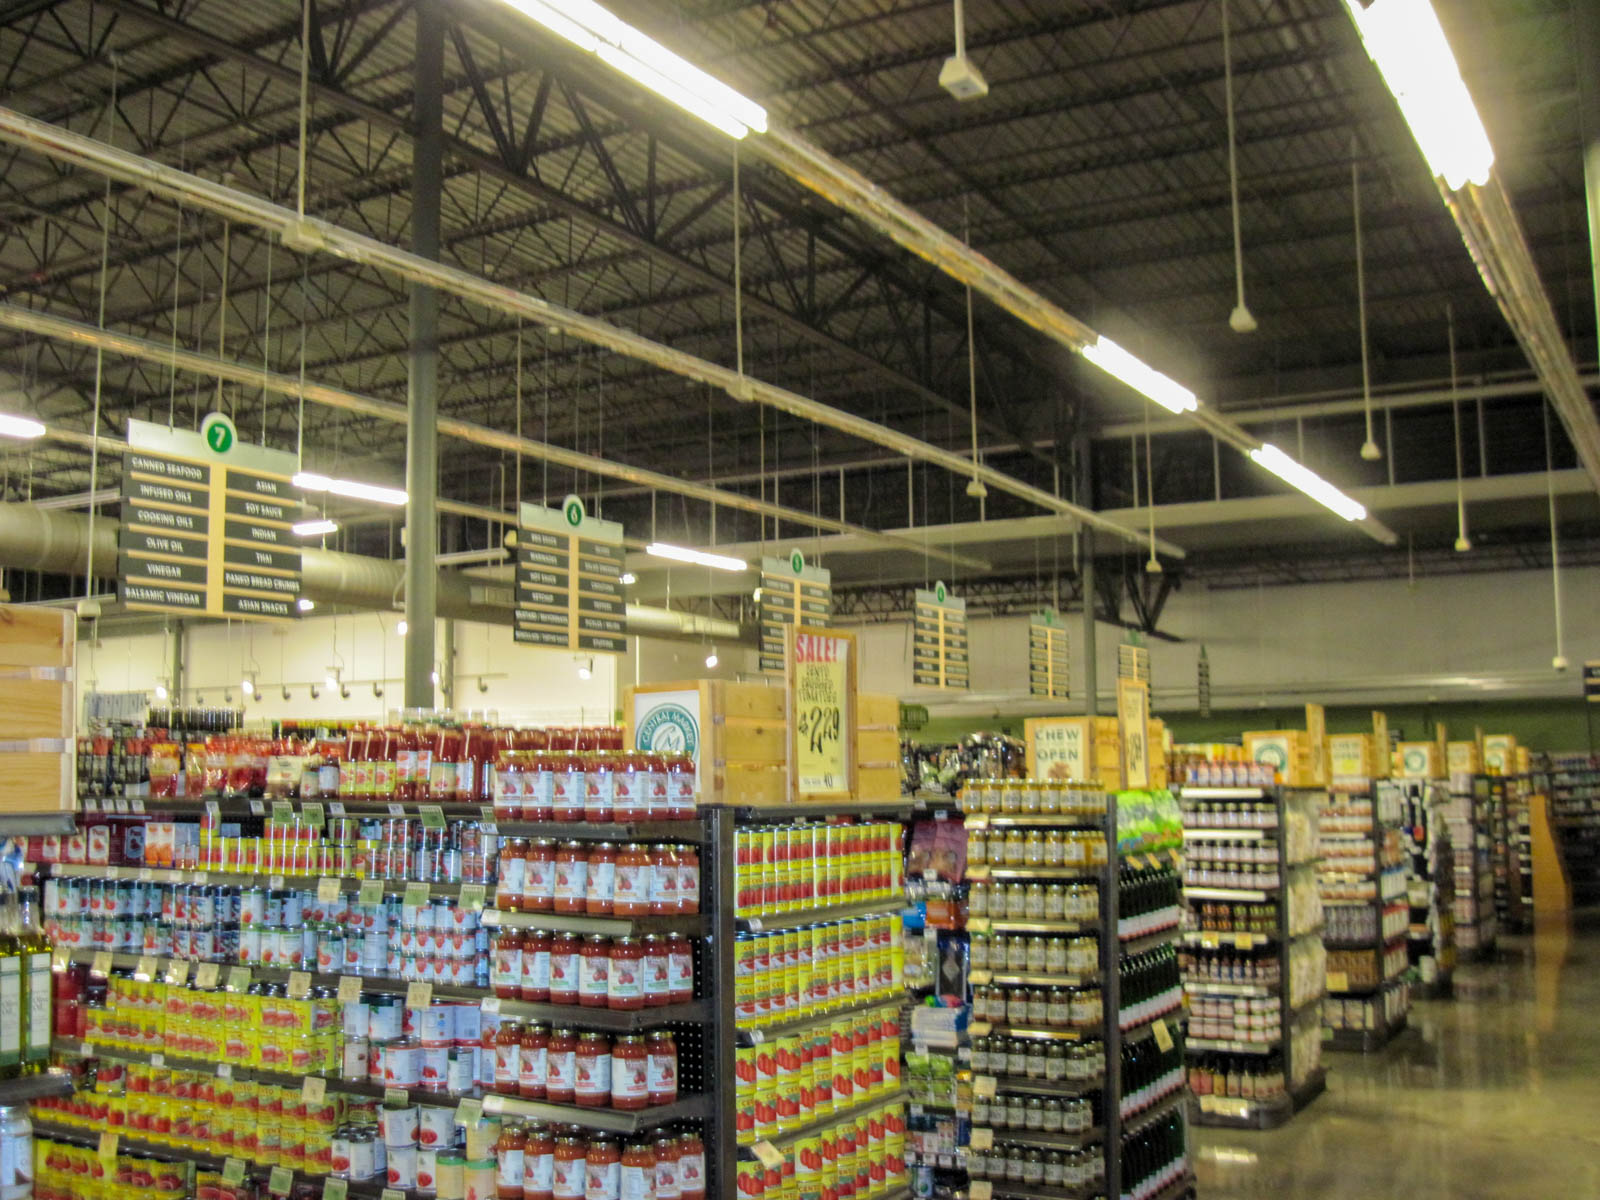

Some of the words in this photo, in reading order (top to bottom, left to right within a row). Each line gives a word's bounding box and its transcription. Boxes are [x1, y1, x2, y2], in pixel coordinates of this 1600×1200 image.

[214, 426, 226, 449] 7
[131, 457, 165, 472] CANNED
[167, 463, 202, 480] SEAFOOD
[140, 484, 173, 500] INFUSED
[175, 490, 192, 503] OILS
[256, 480, 276, 494] ASIAN
[246, 502, 259, 515] SOY
[261, 504, 282, 519] SAUCE
[138, 510, 174, 526] COOKING
[176, 516, 193, 529] OILS
[252, 527, 276, 542] INDIAN
[146, 537, 168, 551] OLIVE
[170, 541, 184, 553] OIL
[256, 551, 272, 565] THAI
[147, 563, 181, 578] VINEGAR
[226, 572, 250, 586] PANKO
[251, 575, 273, 589] BREAD
[125, 587, 165, 602] BALSAMIC
[166, 591, 200, 606] VINEGAR
[239, 599, 260, 613] ASIAN
[261, 600, 288, 615] SNACKS
[796, 635, 838, 664] SALE!
[642, 711, 670, 742] CENTRAL
[1035, 728, 1079, 740] CHEW
[1037, 749, 1078, 761] OPEN
